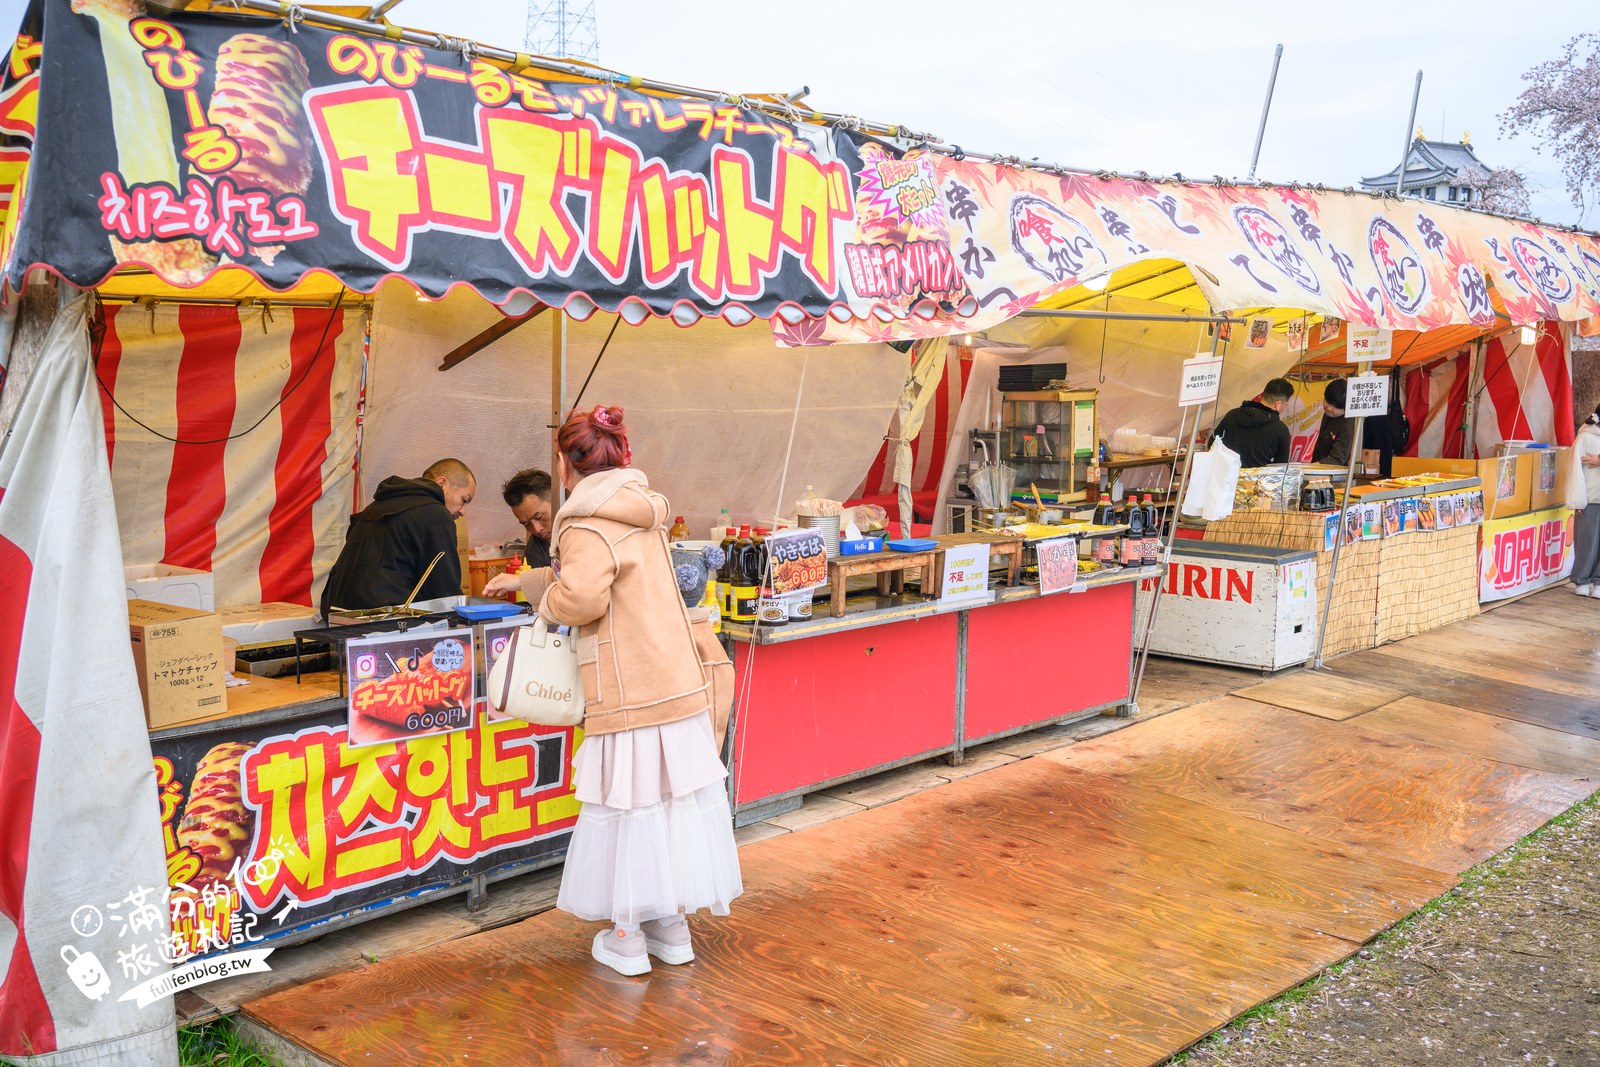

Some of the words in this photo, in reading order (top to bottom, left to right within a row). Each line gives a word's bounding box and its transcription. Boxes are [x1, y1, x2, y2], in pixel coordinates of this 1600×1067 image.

[130, 17, 241, 173] のびーる
[303, 80, 857, 305] チーズハットグ
[98, 172, 320, 257] 치즈핫도그
[1353, 340, 1369, 348] 不足
[775, 537, 822, 563] やきそば
[1041, 543, 1074, 565] いか串
[1494, 520, 1566, 590] 10円パン
[792, 565, 825, 585] 600円
[949, 571, 964, 583] 不足
[154, 661, 218, 680] トマトケチャップ
[160, 652, 213, 668] ジェフダベーシック
[355, 675, 468, 711] チーズハットグ
[525, 680, 572, 702] Chloé
[407, 708, 461, 730] 600円
